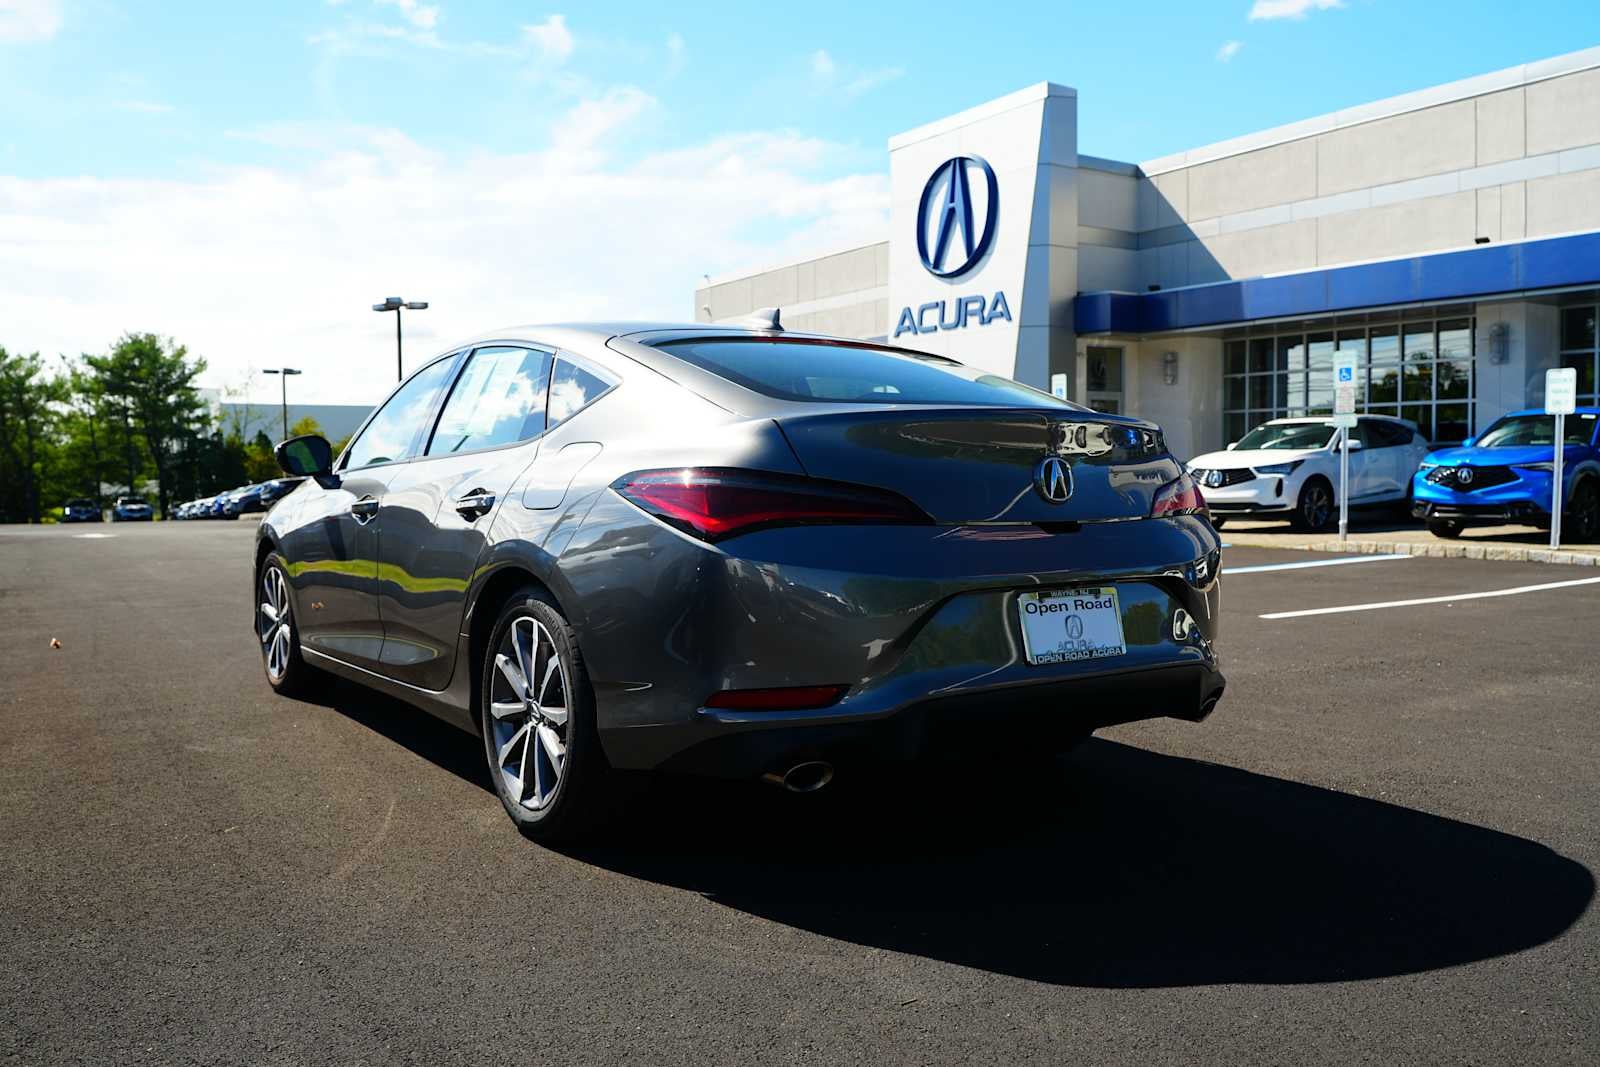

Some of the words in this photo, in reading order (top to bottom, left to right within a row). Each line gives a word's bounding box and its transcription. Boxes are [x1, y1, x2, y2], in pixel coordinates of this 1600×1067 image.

[894, 291, 1012, 338] ACURA
[1025, 602, 1069, 616] Open
[1074, 598, 1112, 611] Road
[1037, 652, 1063, 664] OPEN
[1065, 649, 1090, 661] ROAD
[1092, 646, 1122, 658] ACURA
